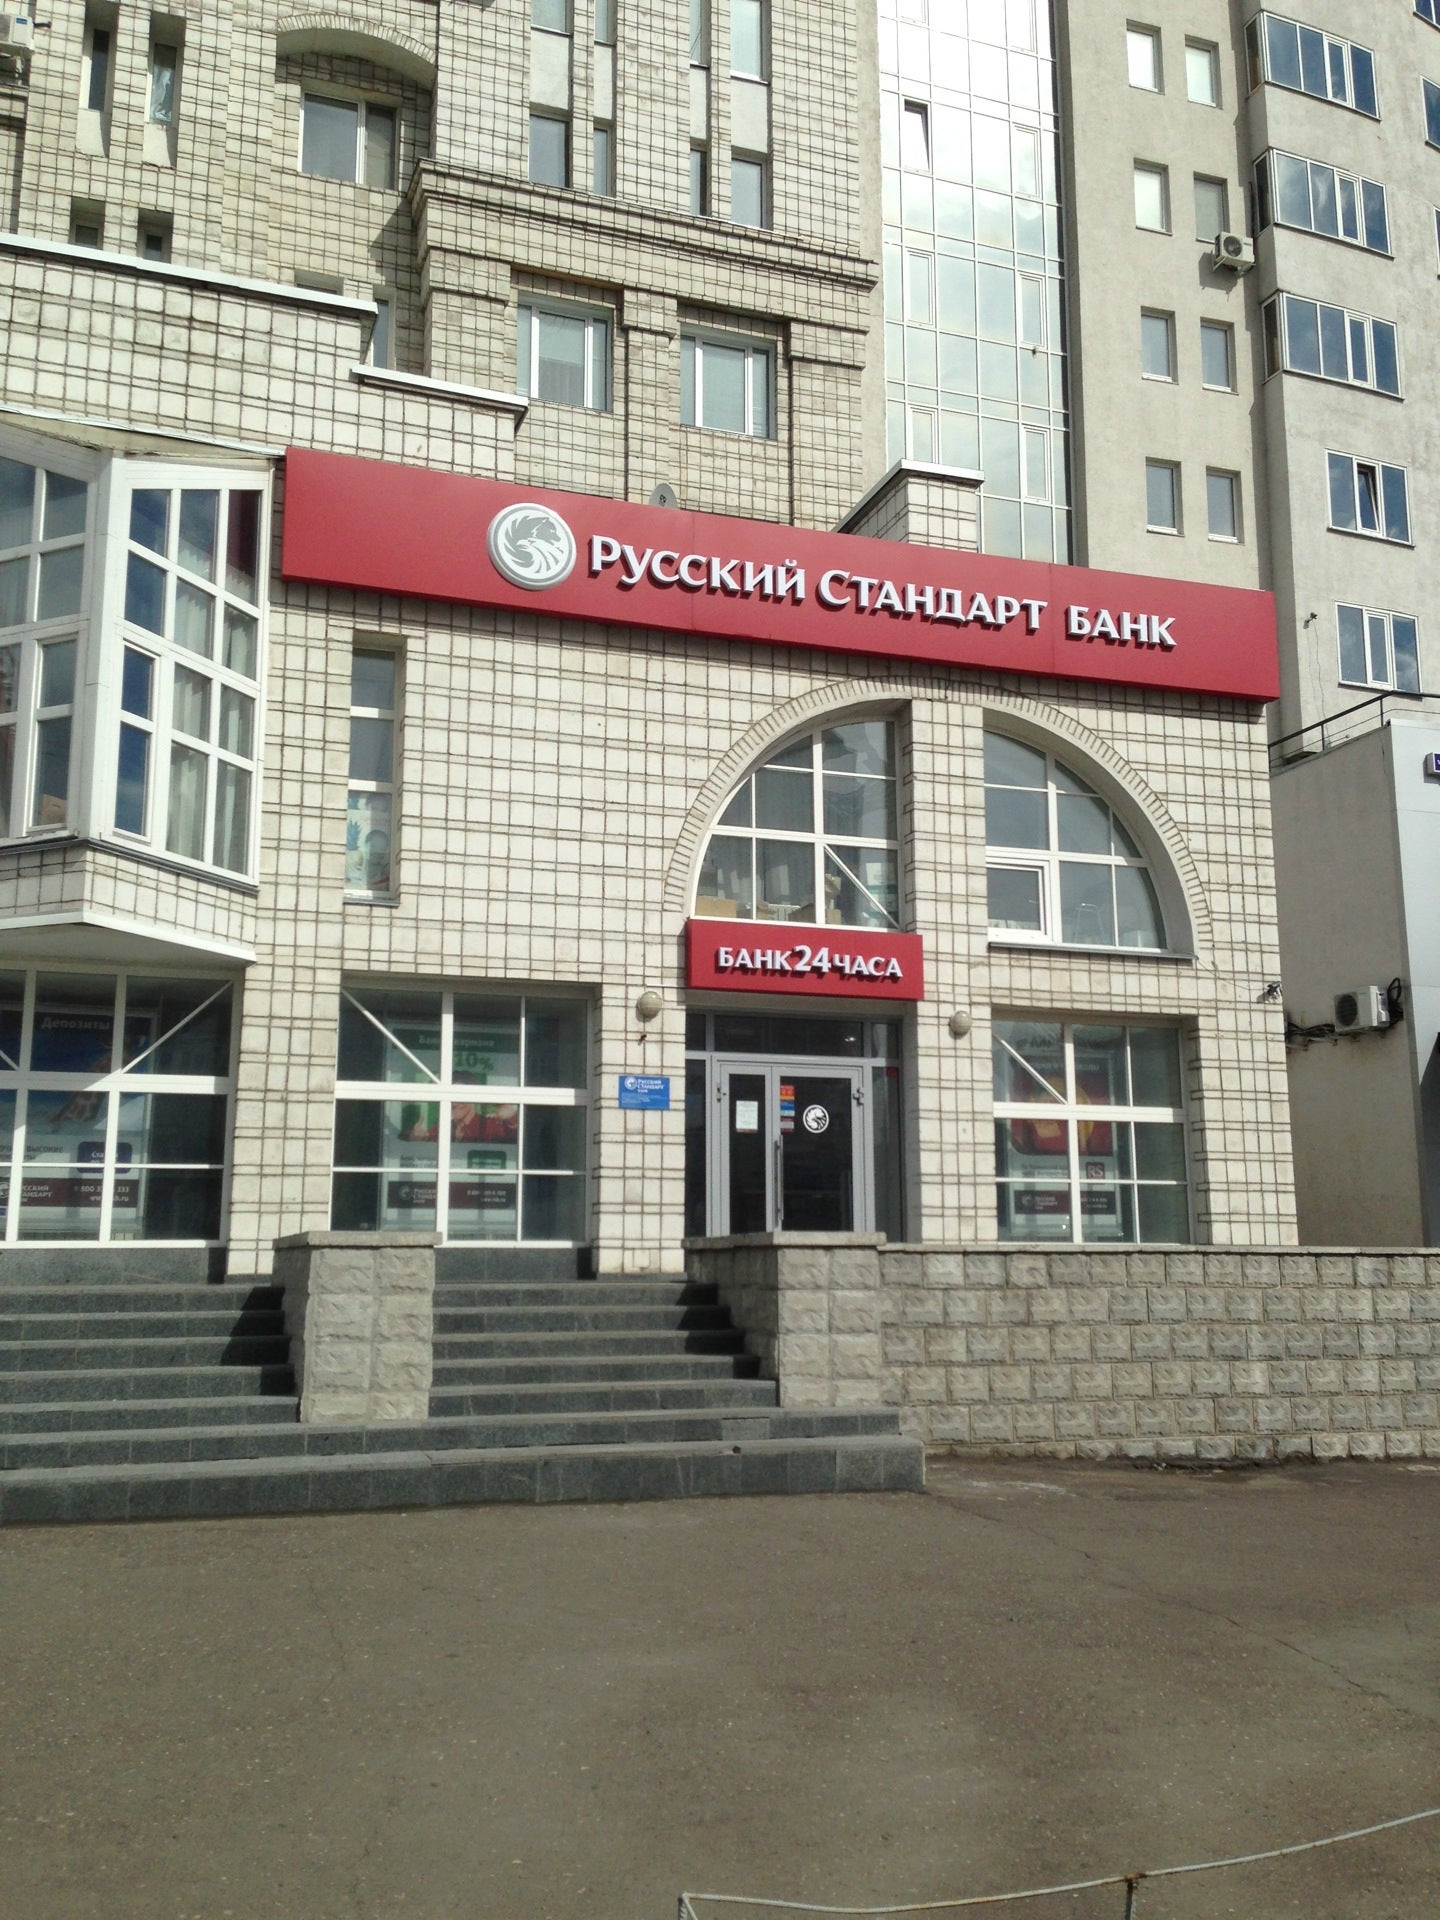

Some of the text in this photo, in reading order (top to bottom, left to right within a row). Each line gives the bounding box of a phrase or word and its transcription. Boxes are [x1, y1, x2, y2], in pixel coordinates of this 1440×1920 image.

[590, 534, 1178, 647] РУССКИЙ СТАНДАРТ БАНК
[41, 1016, 111, 1031] Депозиты
[454, 1052, 494, 1072] 10%
[1087, 1164, 1104, 1178] RS
